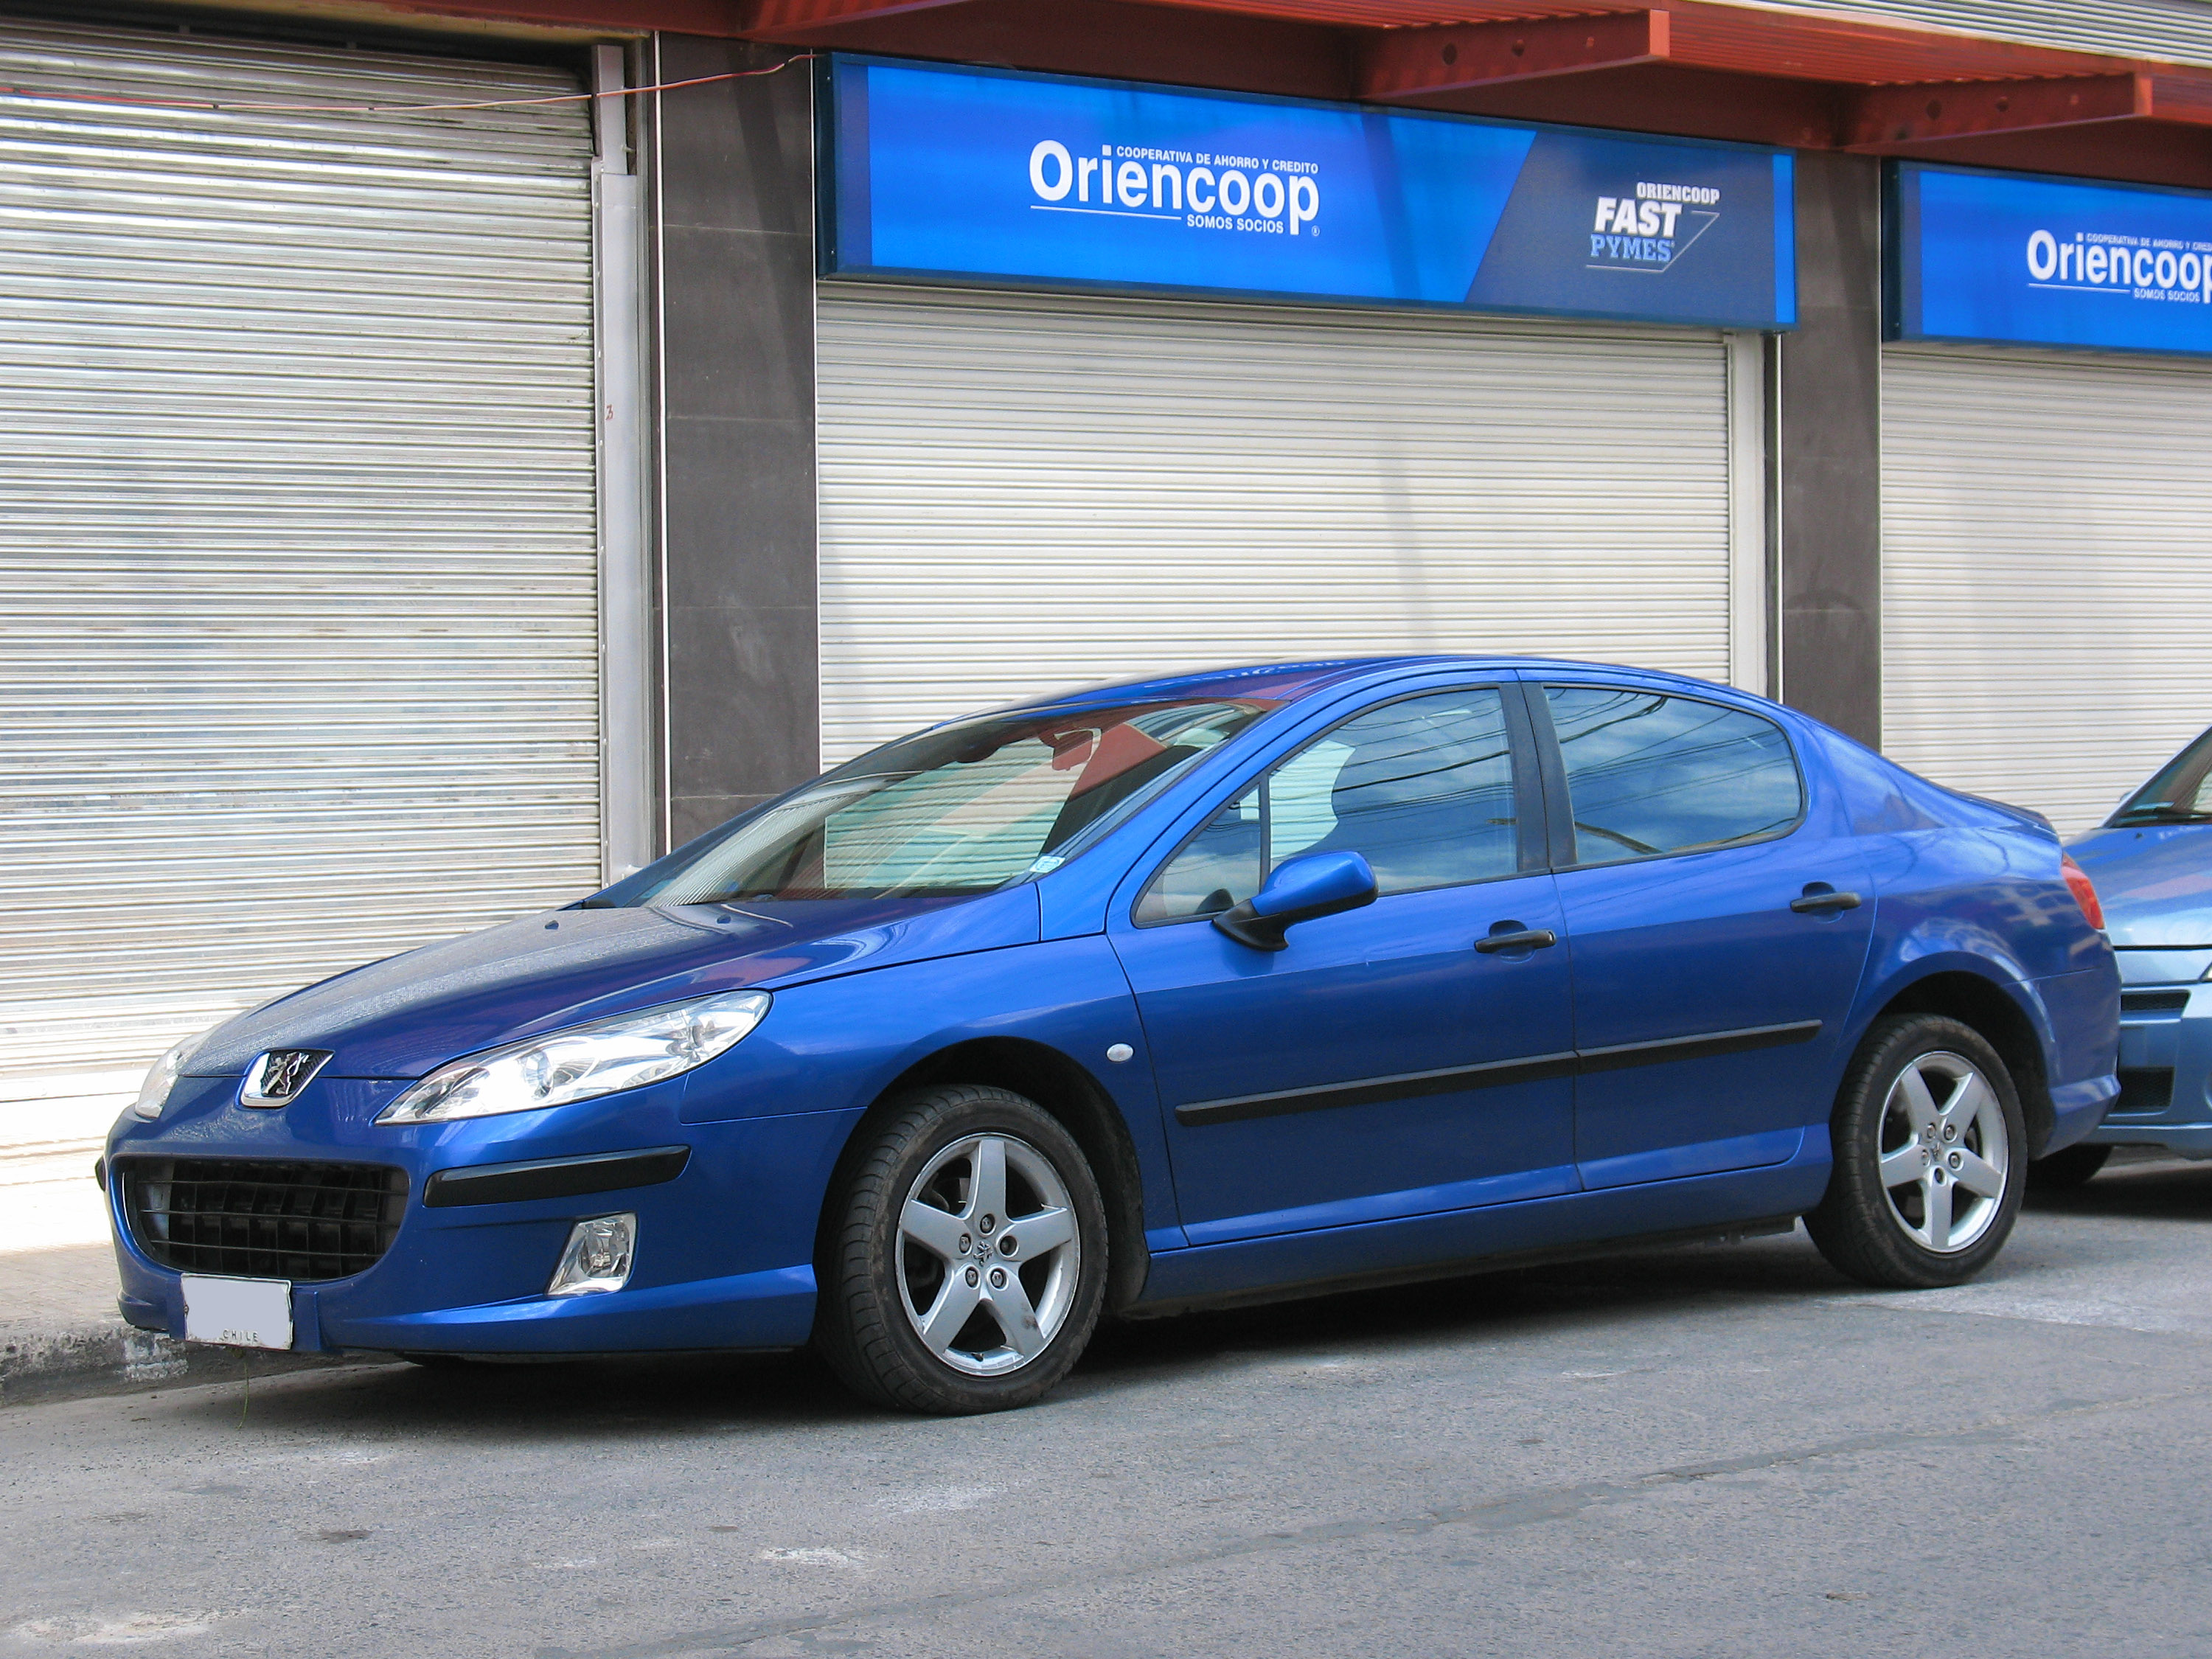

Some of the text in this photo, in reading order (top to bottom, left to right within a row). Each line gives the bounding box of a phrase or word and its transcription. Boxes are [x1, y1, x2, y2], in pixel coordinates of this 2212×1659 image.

[1116, 146, 1319, 174] COOPERATIVA DE AHORRO Y CREDITO
[1029, 140, 1320, 235] Oriencoop
[1636, 181, 1720, 204] ORIENCOOP
[1187, 214, 1284, 234] SOMOS SOCIOS
[1594, 196, 1683, 237] FAST
[1590, 234, 1672, 262] PYMES
[2134, 288, 2201, 303] SOMOS SOCIOS
[223, 1329, 258, 1342] CHILE
